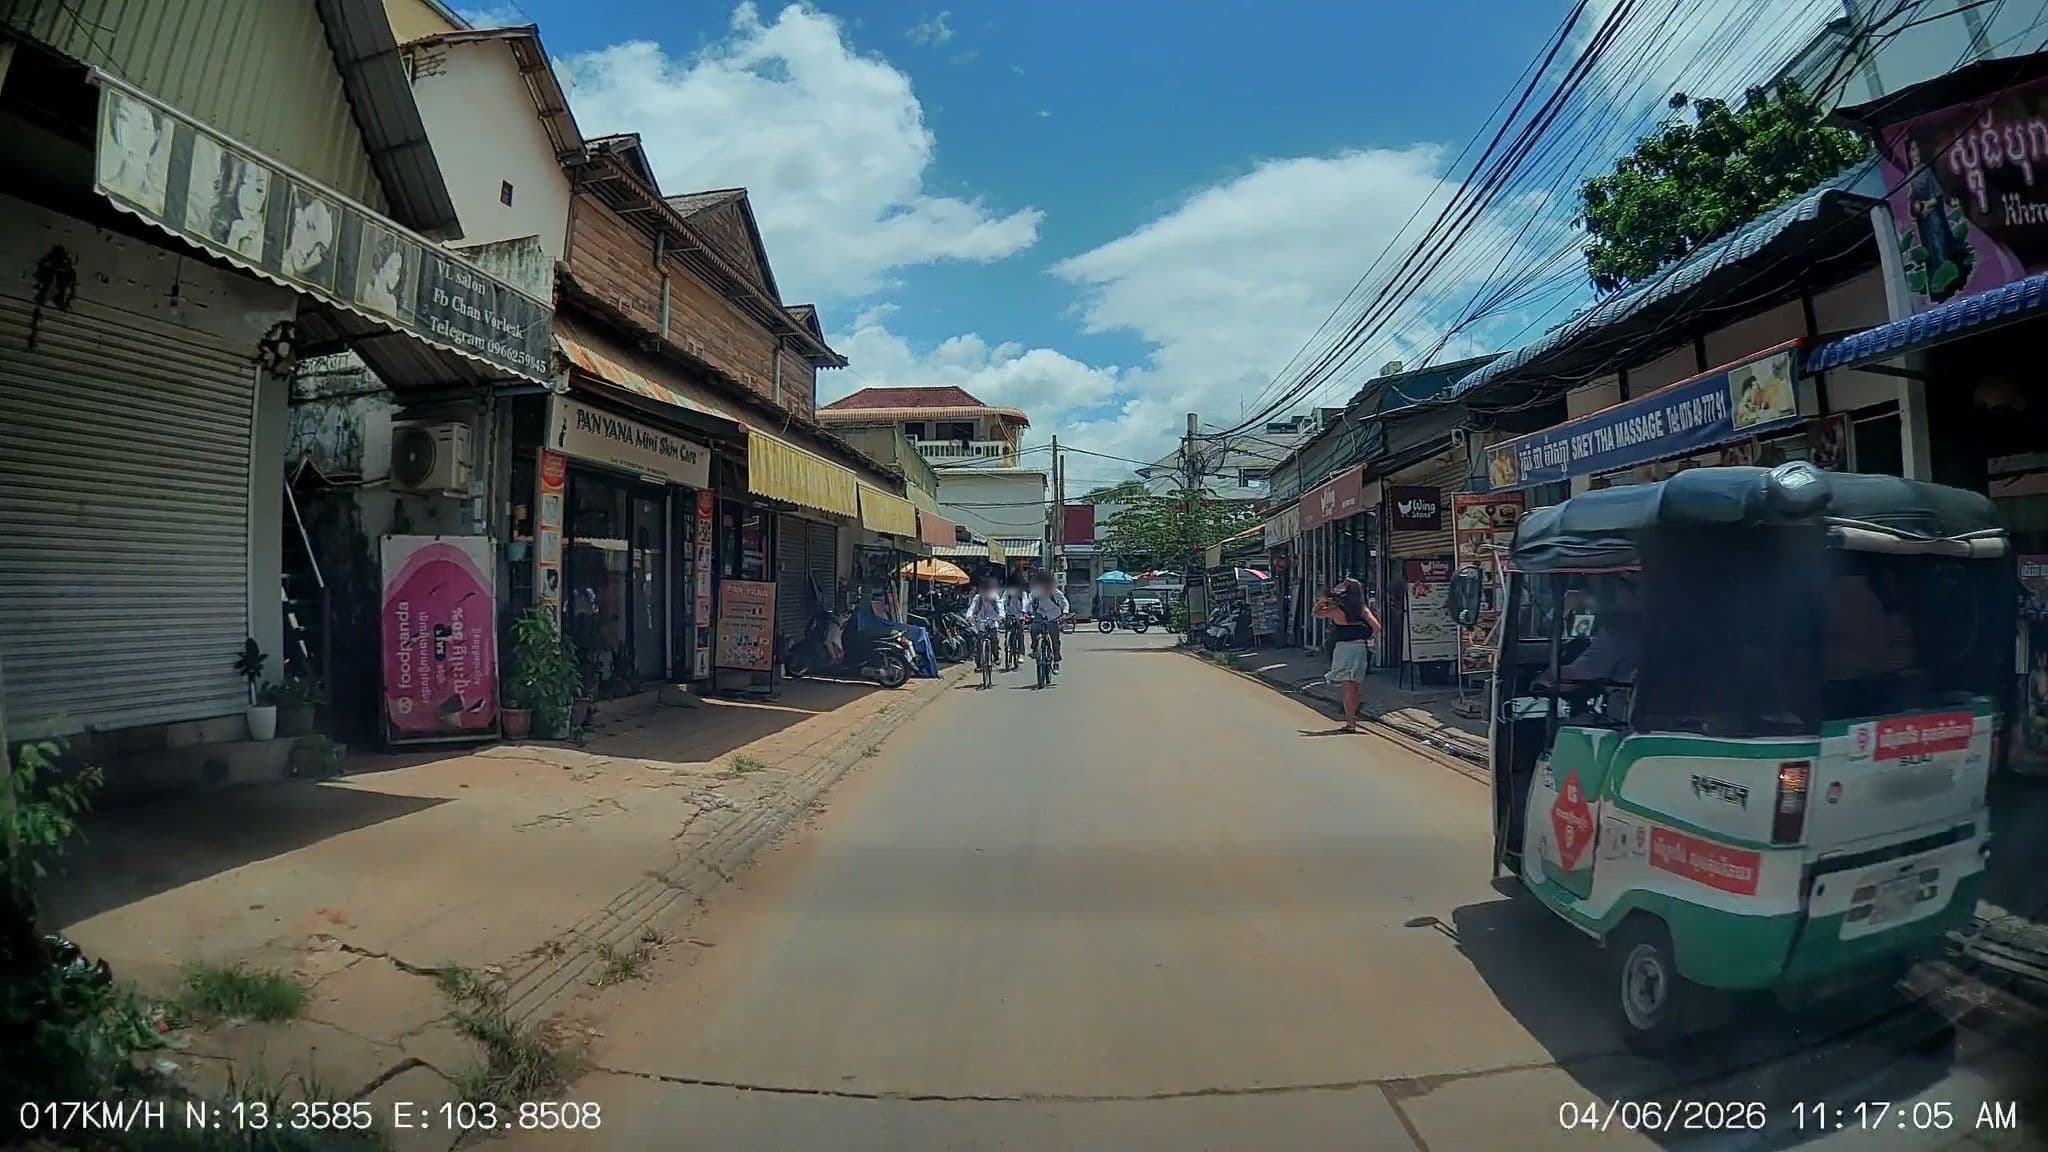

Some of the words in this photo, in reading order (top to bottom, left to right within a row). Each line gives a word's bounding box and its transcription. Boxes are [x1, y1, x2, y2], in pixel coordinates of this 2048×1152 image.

[432, 287, 449, 307] Fb
[452, 296, 481, 321] Chan
[456, 272, 486, 295] salon
[430, 316, 485, 350] Telegram
[487, 339, 546, 374] 0966259845
[576, 408, 601, 435] PAN
[603, 418, 634, 446] YANA
[635, 429, 658, 453] Mini
[660, 437, 679, 461] Skin
[680, 444, 697, 465] Care
[1572, 430, 1594, 461] SREY
[1594, 426, 1615, 454] THA
[1615, 410, 1665, 449] MASSAGE
[1412, 498, 1436, 514] Wing
[395, 601, 411, 689] foodpanda
